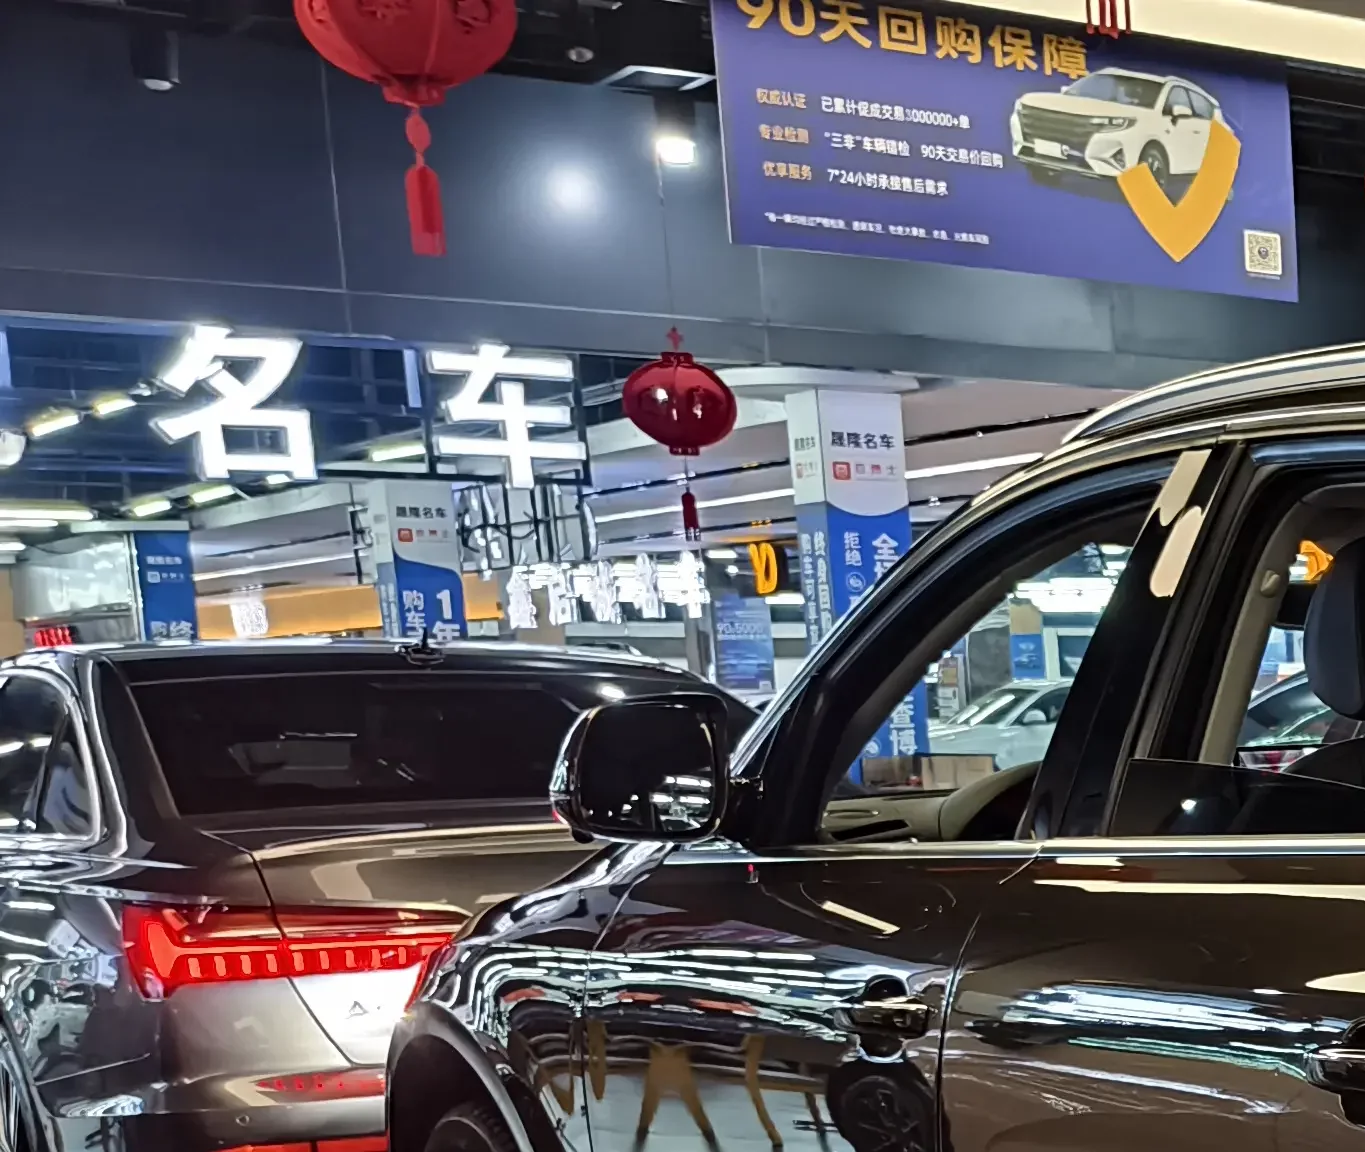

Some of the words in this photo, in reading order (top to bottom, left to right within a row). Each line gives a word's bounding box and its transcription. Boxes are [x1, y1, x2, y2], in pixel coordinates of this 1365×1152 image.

[736, 0, 1091, 79] 90天回购保障
